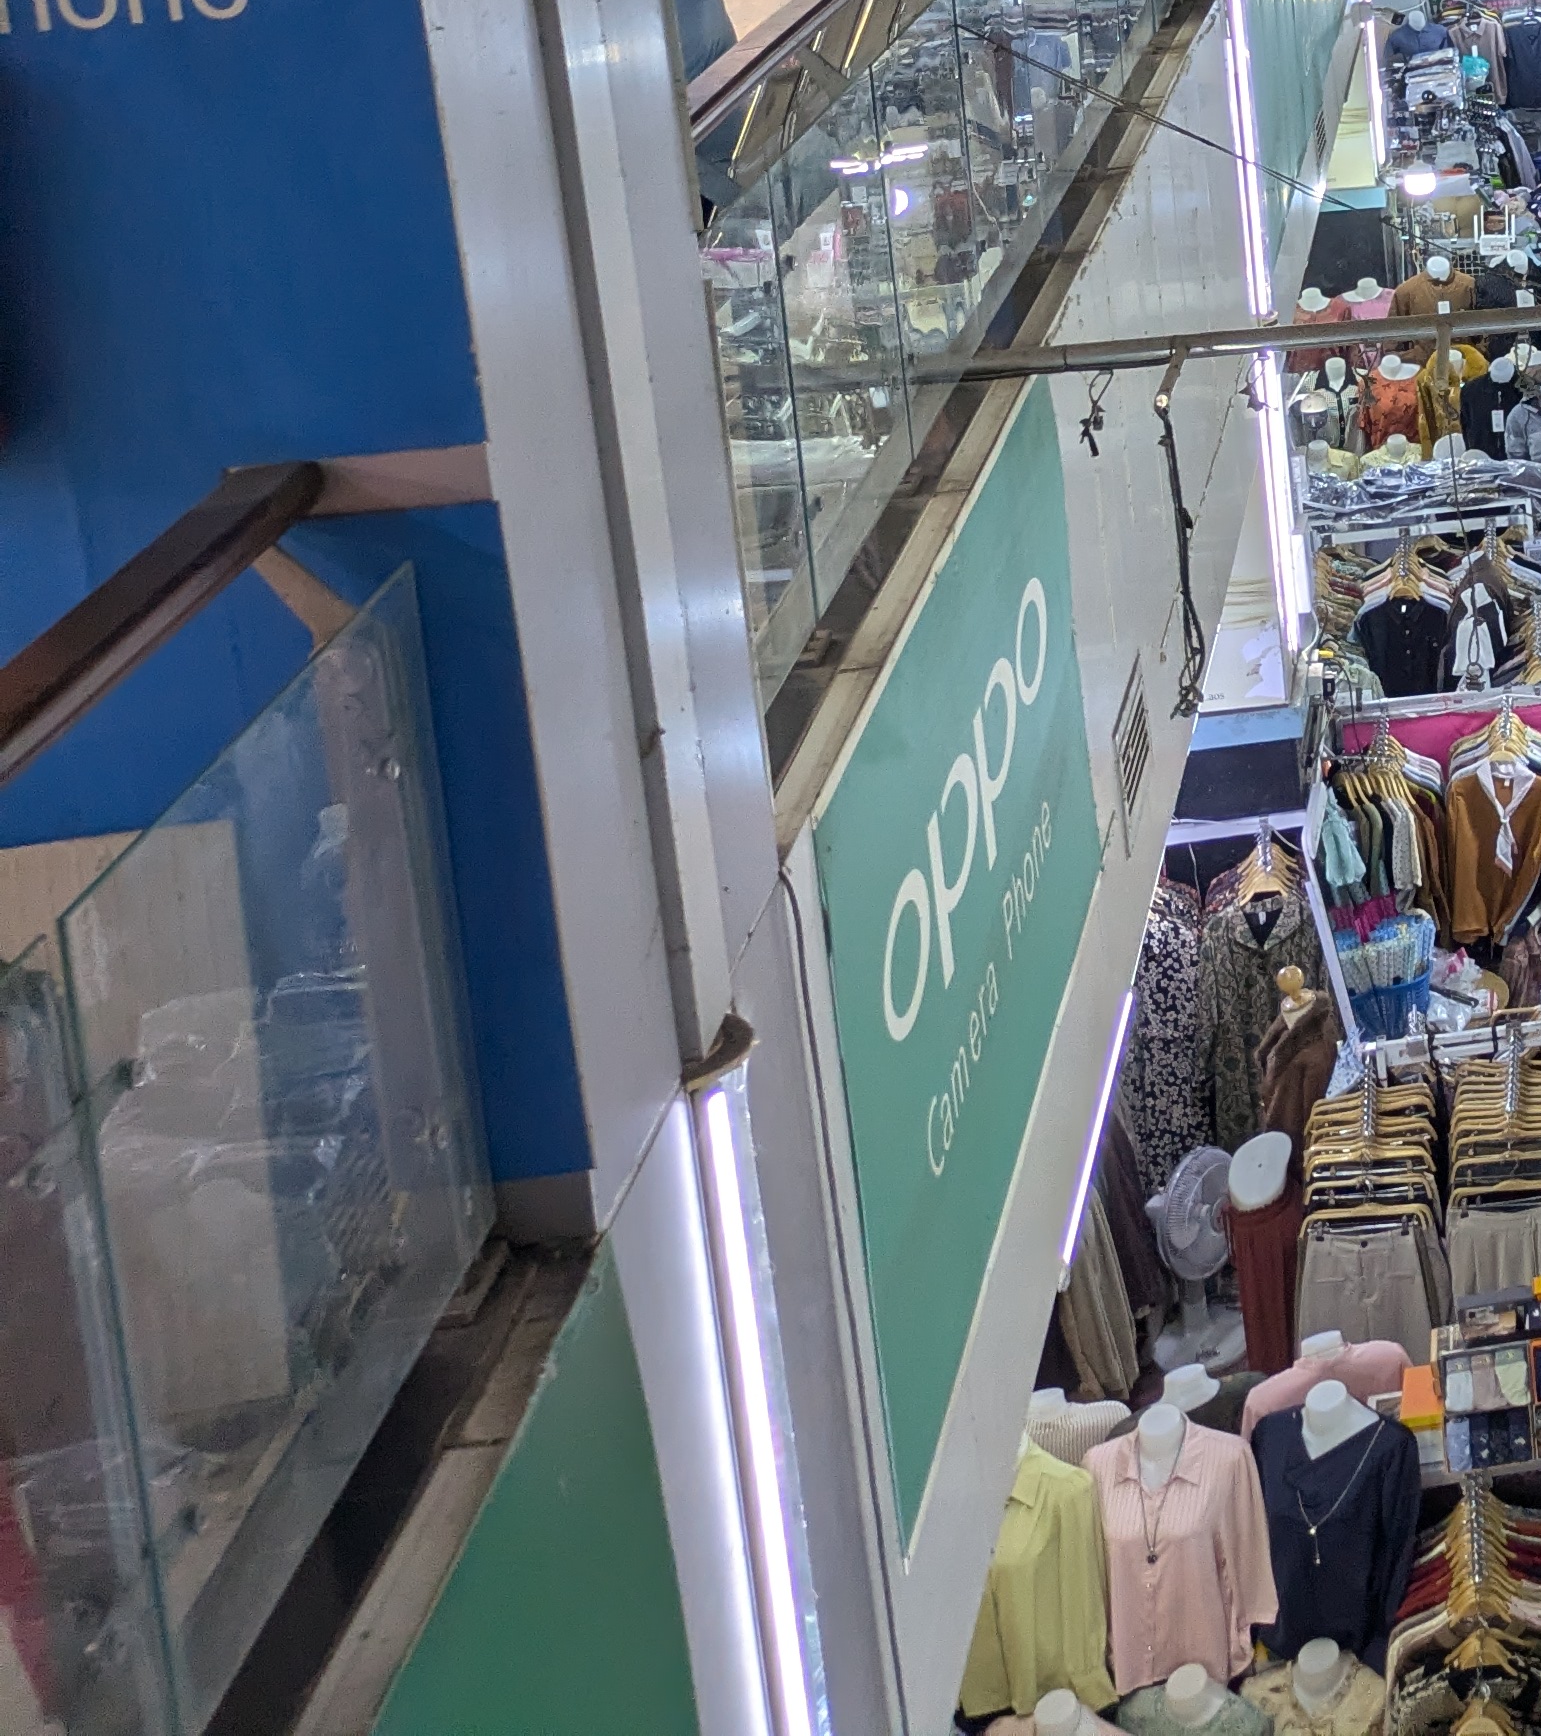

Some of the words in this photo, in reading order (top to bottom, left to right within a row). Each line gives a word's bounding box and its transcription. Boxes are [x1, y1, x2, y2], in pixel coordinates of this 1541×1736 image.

[883, 577, 1048, 1043] oppo
[927, 960, 1001, 1179] Camera
[1002, 800, 1053, 962] Phone
